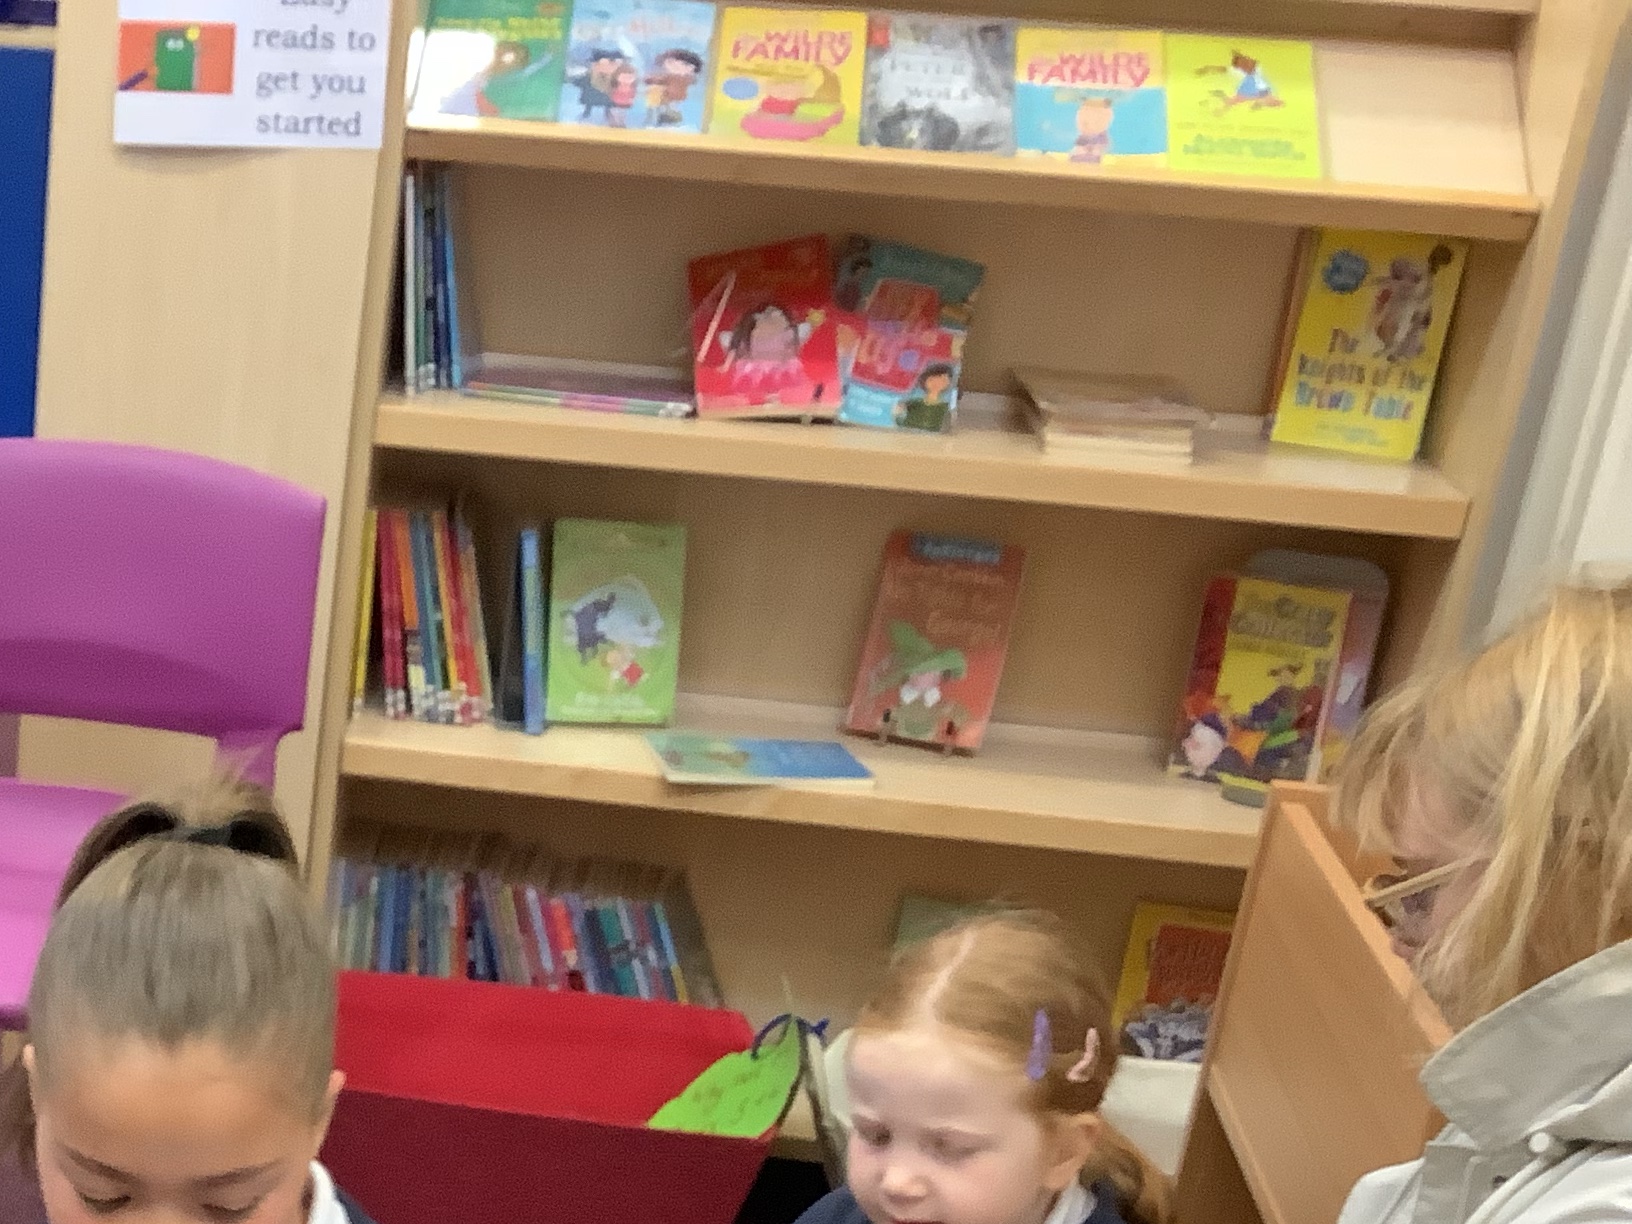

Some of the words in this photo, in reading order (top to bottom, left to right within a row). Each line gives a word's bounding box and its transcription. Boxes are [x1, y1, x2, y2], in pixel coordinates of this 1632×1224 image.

[253, 23, 336, 51] reads
[347, 28, 376, 52] to
[256, 70, 299, 99] get
[309, 73, 366, 99] you
[256, 110, 362, 136] started
